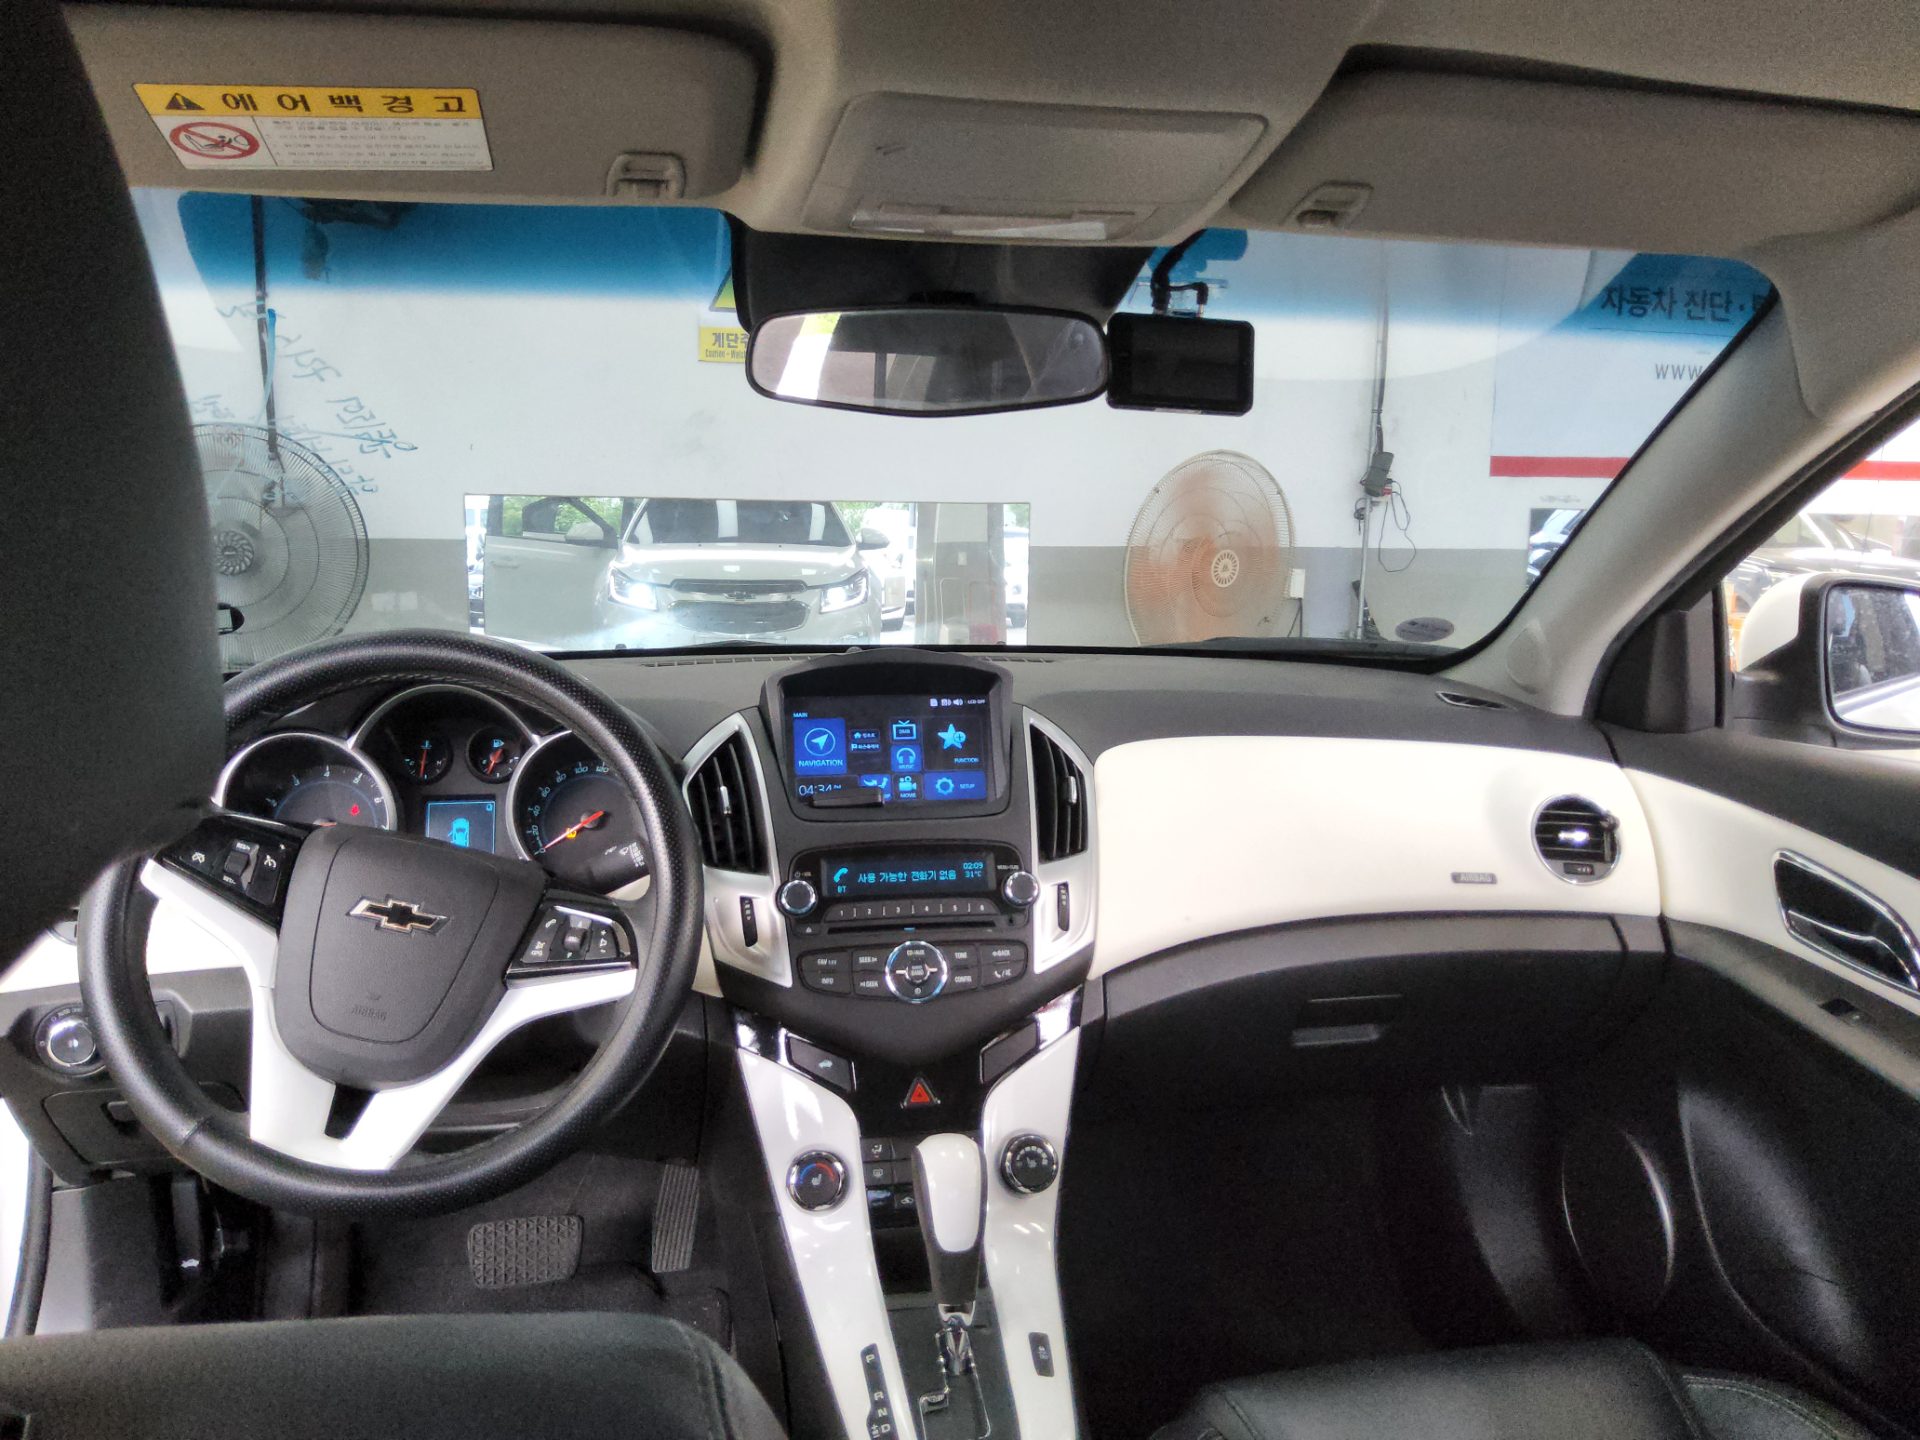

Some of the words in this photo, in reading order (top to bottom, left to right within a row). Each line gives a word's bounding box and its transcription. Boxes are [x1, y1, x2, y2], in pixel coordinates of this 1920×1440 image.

[1601, 284, 1675, 320] 자동차
[798, 759, 843, 767] NAVIGATION
[574, 766, 589, 774] 100
[963, 861, 984, 870] 02:09
[857, 872, 877, 883] 사용
[879, 871, 907, 882] 가능한
[911, 870, 937, 881] 전화기
[939, 869, 957, 880] 없음
[837, 885, 847, 893] BT
[821, 976, 835, 985] INFO
[954, 975, 973, 983] CONFIG
